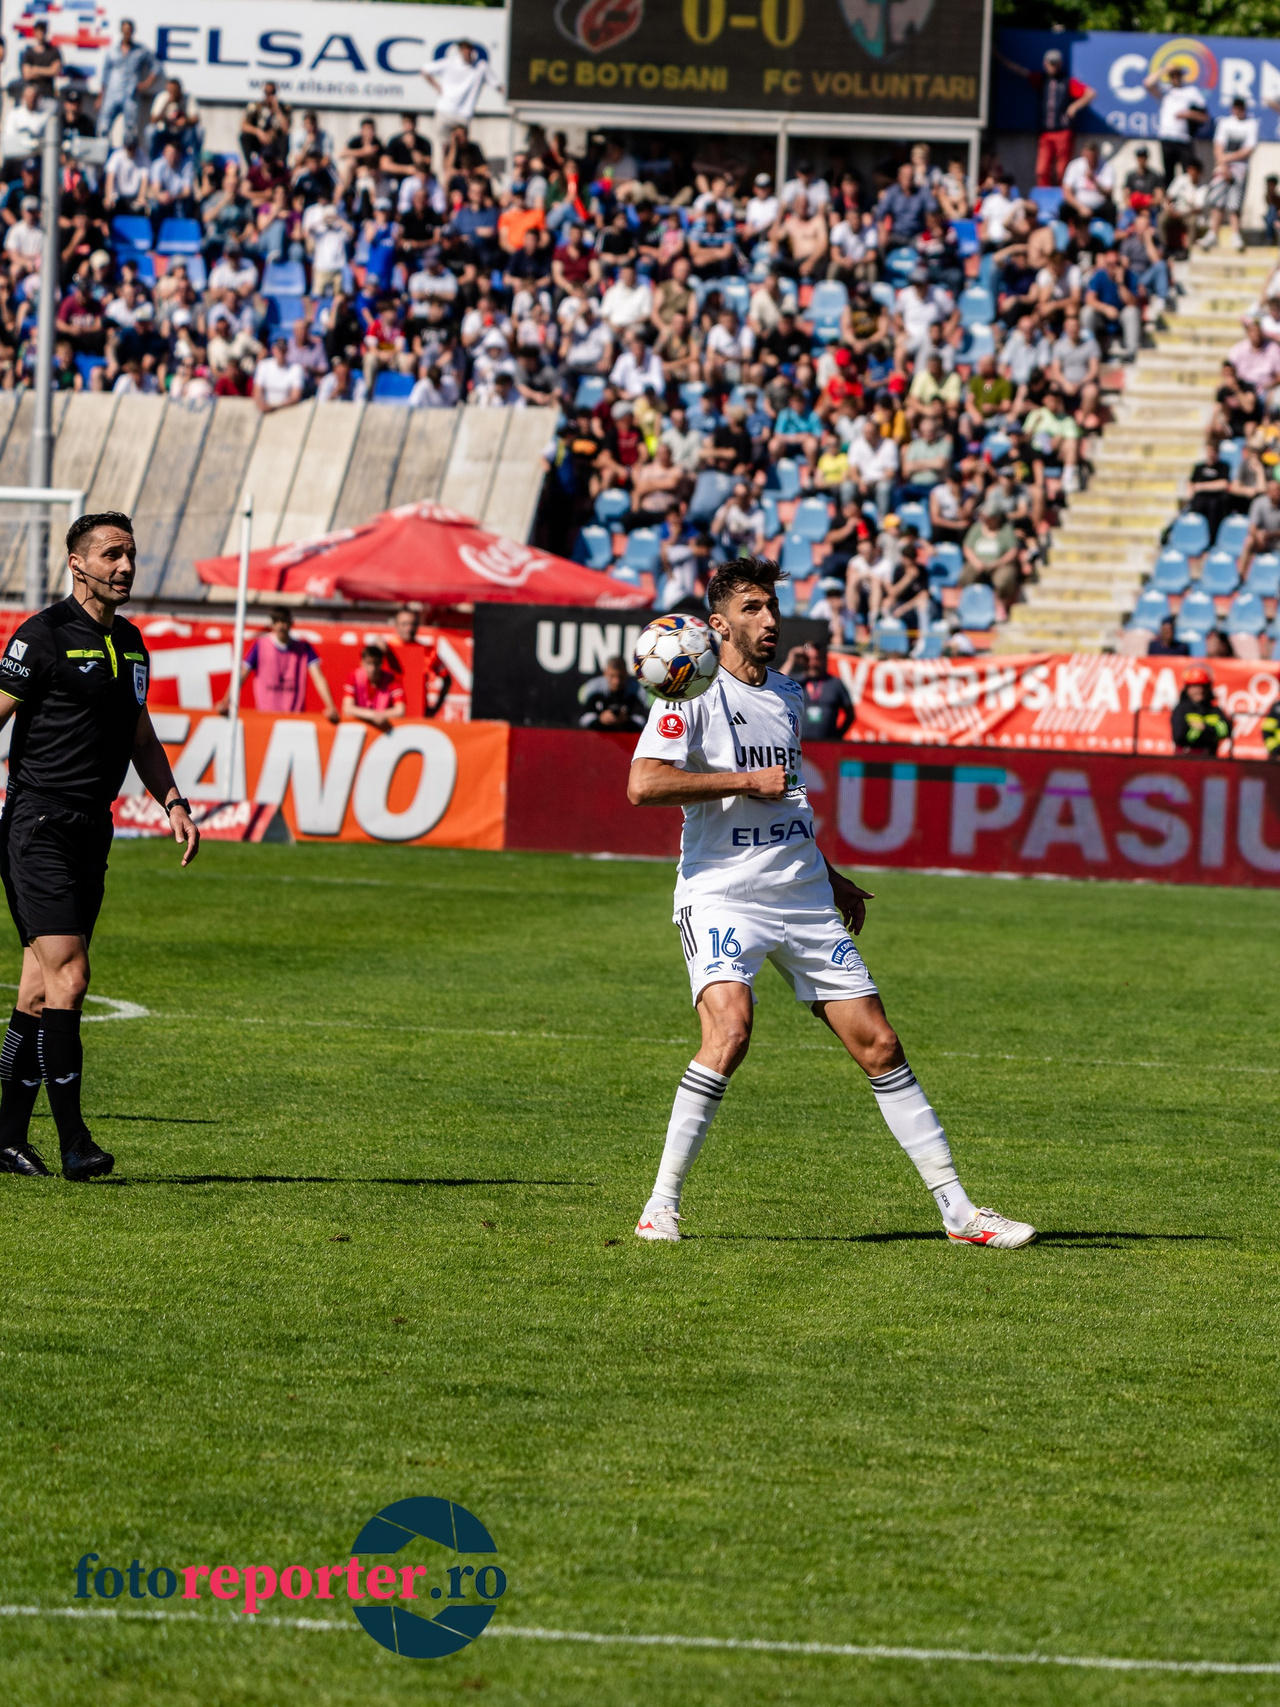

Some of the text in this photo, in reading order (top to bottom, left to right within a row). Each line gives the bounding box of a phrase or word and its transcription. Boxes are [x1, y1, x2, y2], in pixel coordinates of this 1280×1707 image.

[248, 78, 405, 97] ww.elsaco.com
[529, 59, 729, 92] FC BOTOSANI
[763, 68, 976, 100] FC VOLUNTARI
[0, 656, 31, 678] ORDIS
[708, 927, 742, 959] 16
